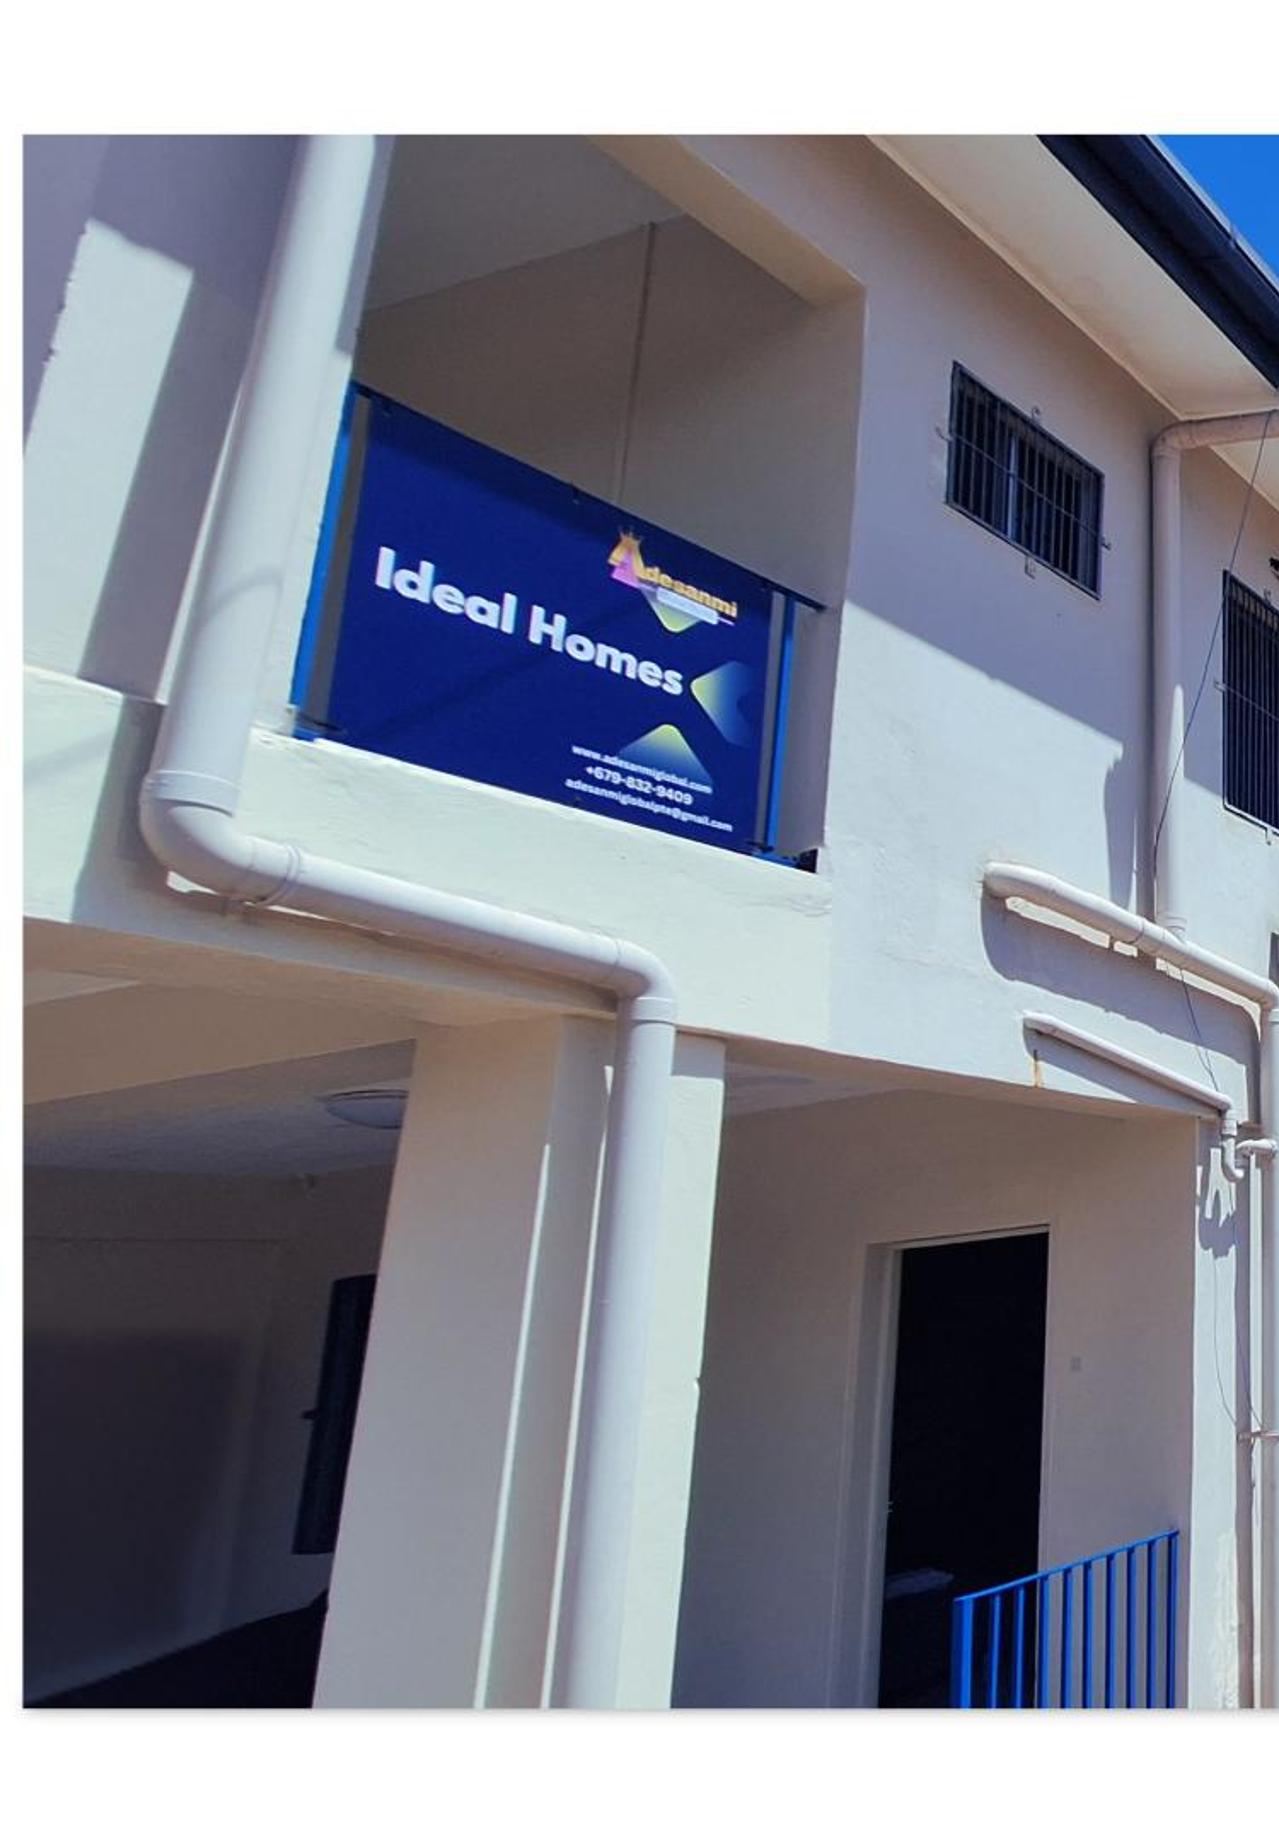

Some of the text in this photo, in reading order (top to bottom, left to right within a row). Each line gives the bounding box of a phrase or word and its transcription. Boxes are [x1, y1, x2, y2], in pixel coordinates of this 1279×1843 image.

[608, 527, 738, 618] Adesanmi
[375, 546, 517, 634] Ideal
[528, 605, 683, 696] Homes
[585, 766, 694, 806] +679-832-9409
